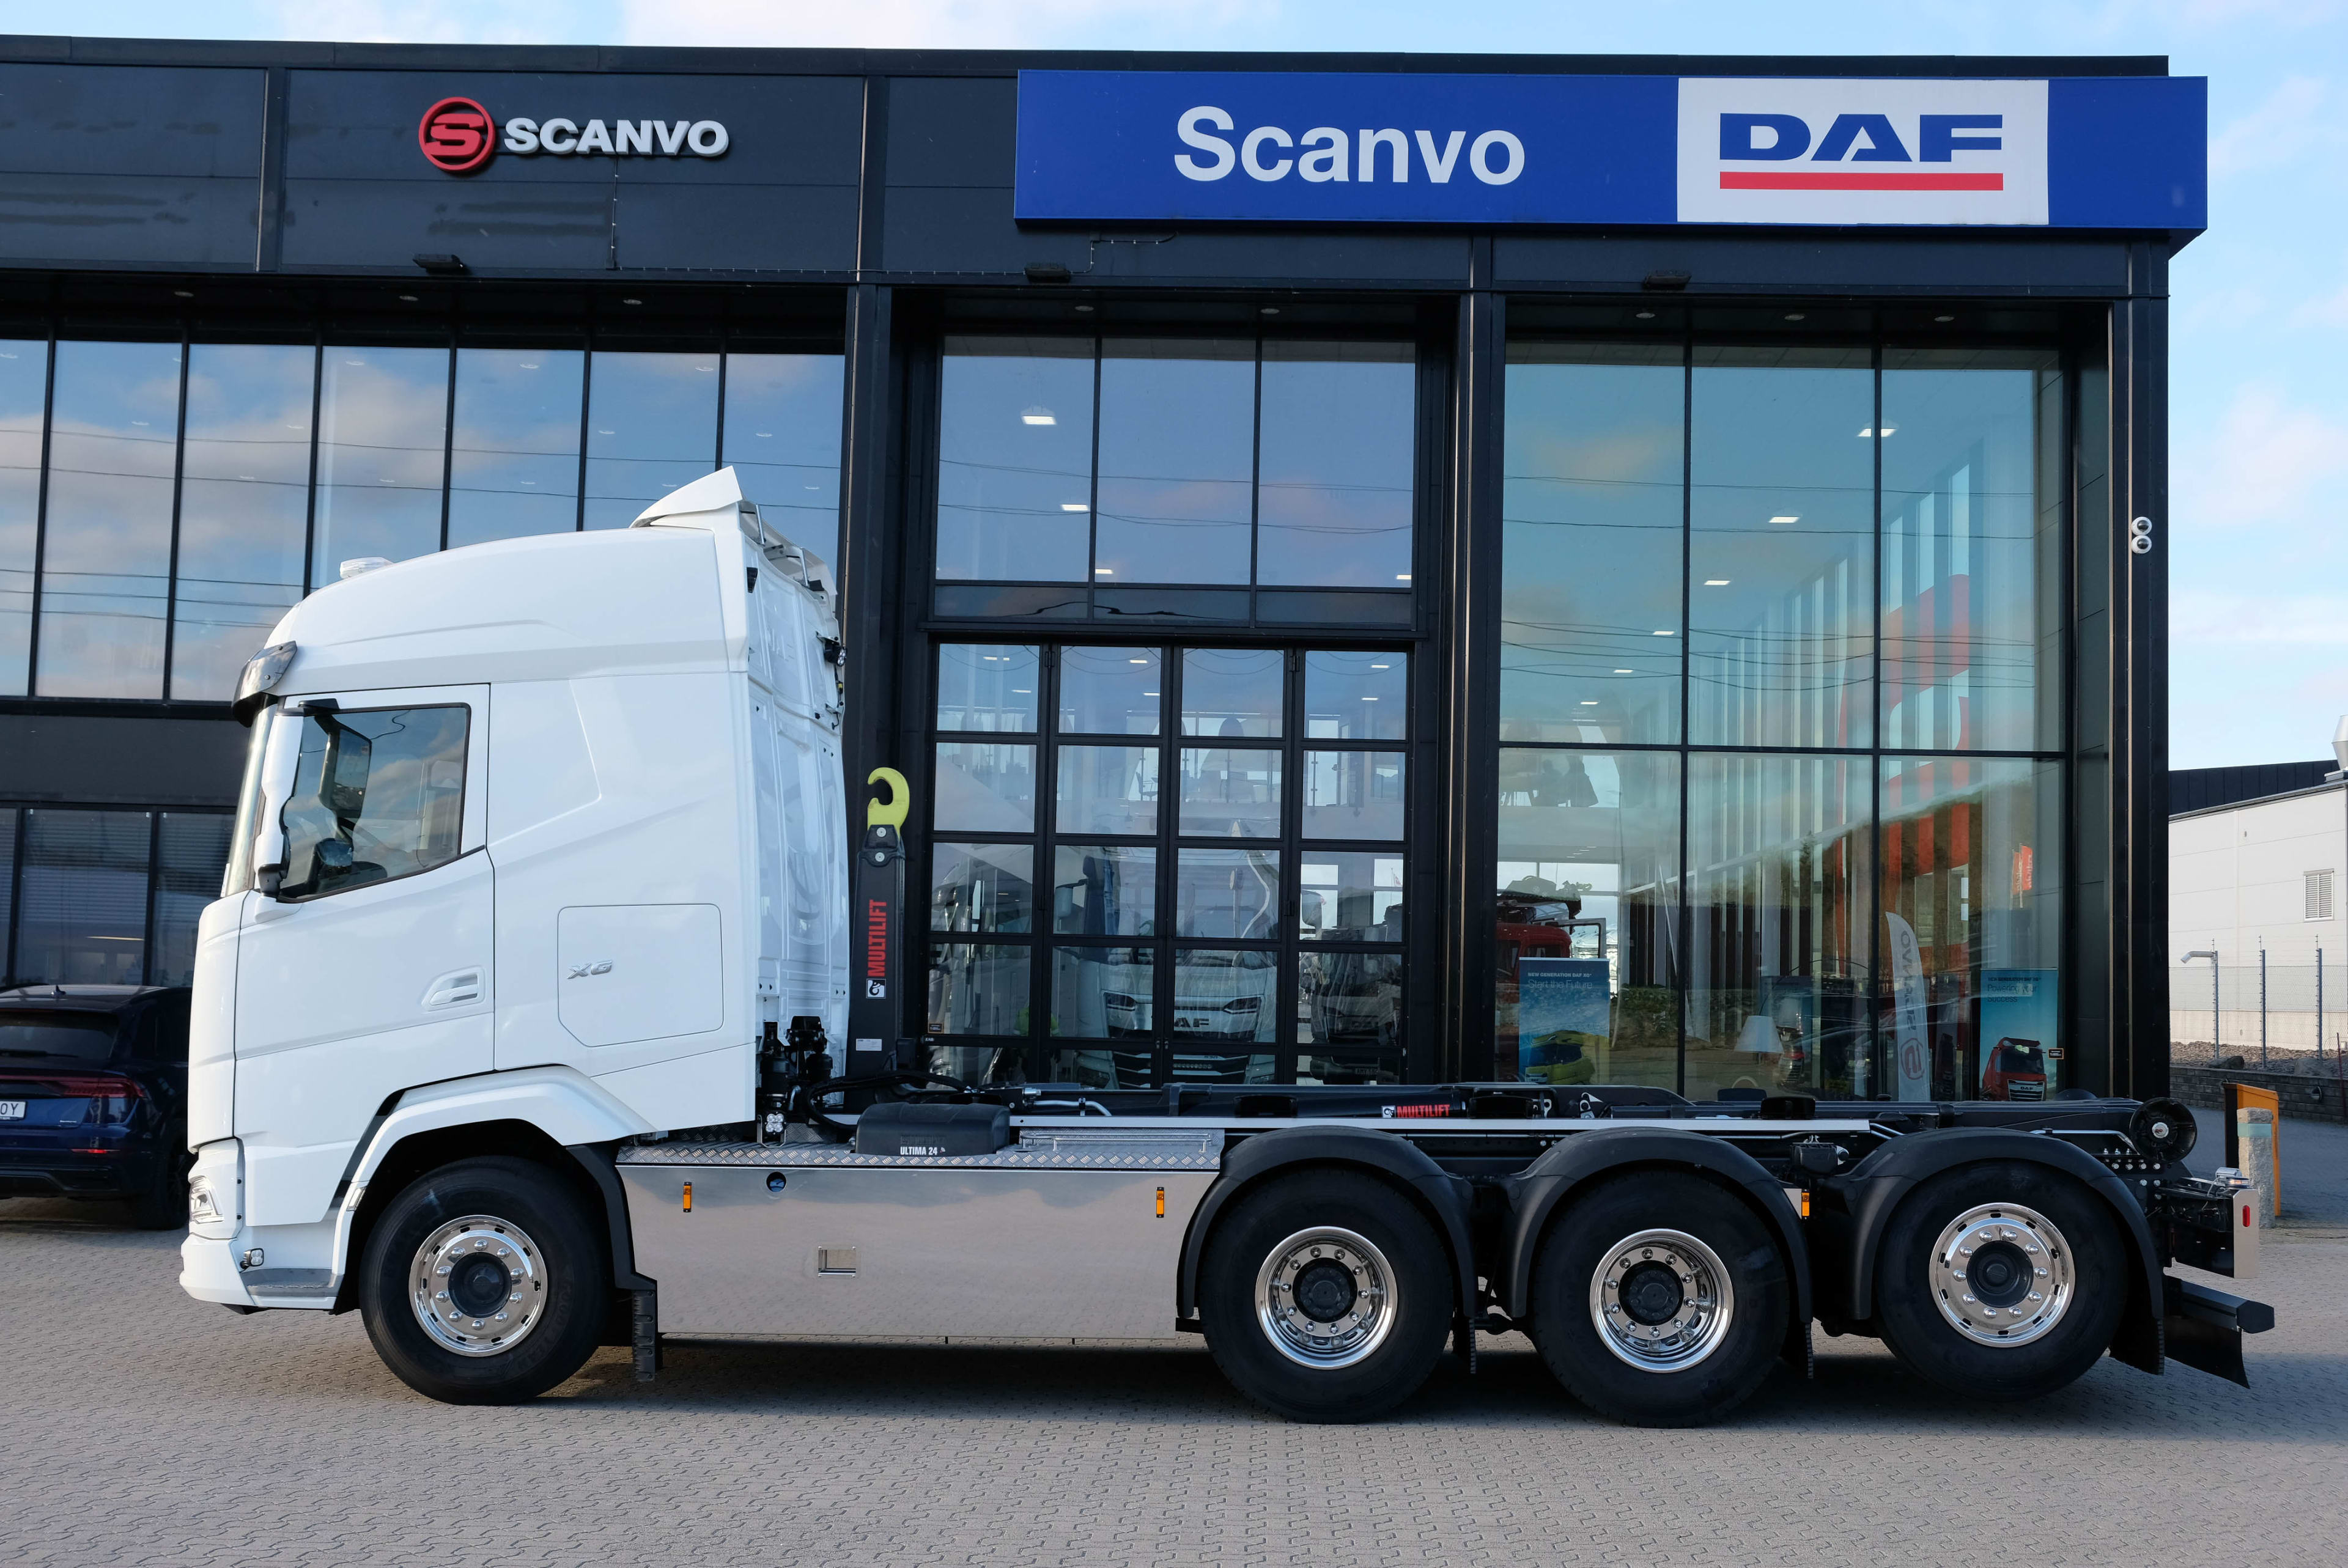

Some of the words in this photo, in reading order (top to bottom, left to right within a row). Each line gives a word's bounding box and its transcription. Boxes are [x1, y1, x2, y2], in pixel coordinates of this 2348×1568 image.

[504, 117, 729, 156] SCANVO
[1175, 106, 1525, 185] Scanvo
[1720, 113, 2003, 162] DAF
[868, 899, 887, 976] MULTILIFT
[567, 960, 612, 979] XG
[1528, 979, 1549, 988] Start
[1551, 979, 1564, 988] the
[1566, 979, 1593, 988] Future
[1173, 1017, 1209, 1028] AF
[1397, 1104, 1450, 1118] MULTILIFT
[900, 1146, 927, 1155] ULTIMA
[928, 1147, 938, 1155] 24
